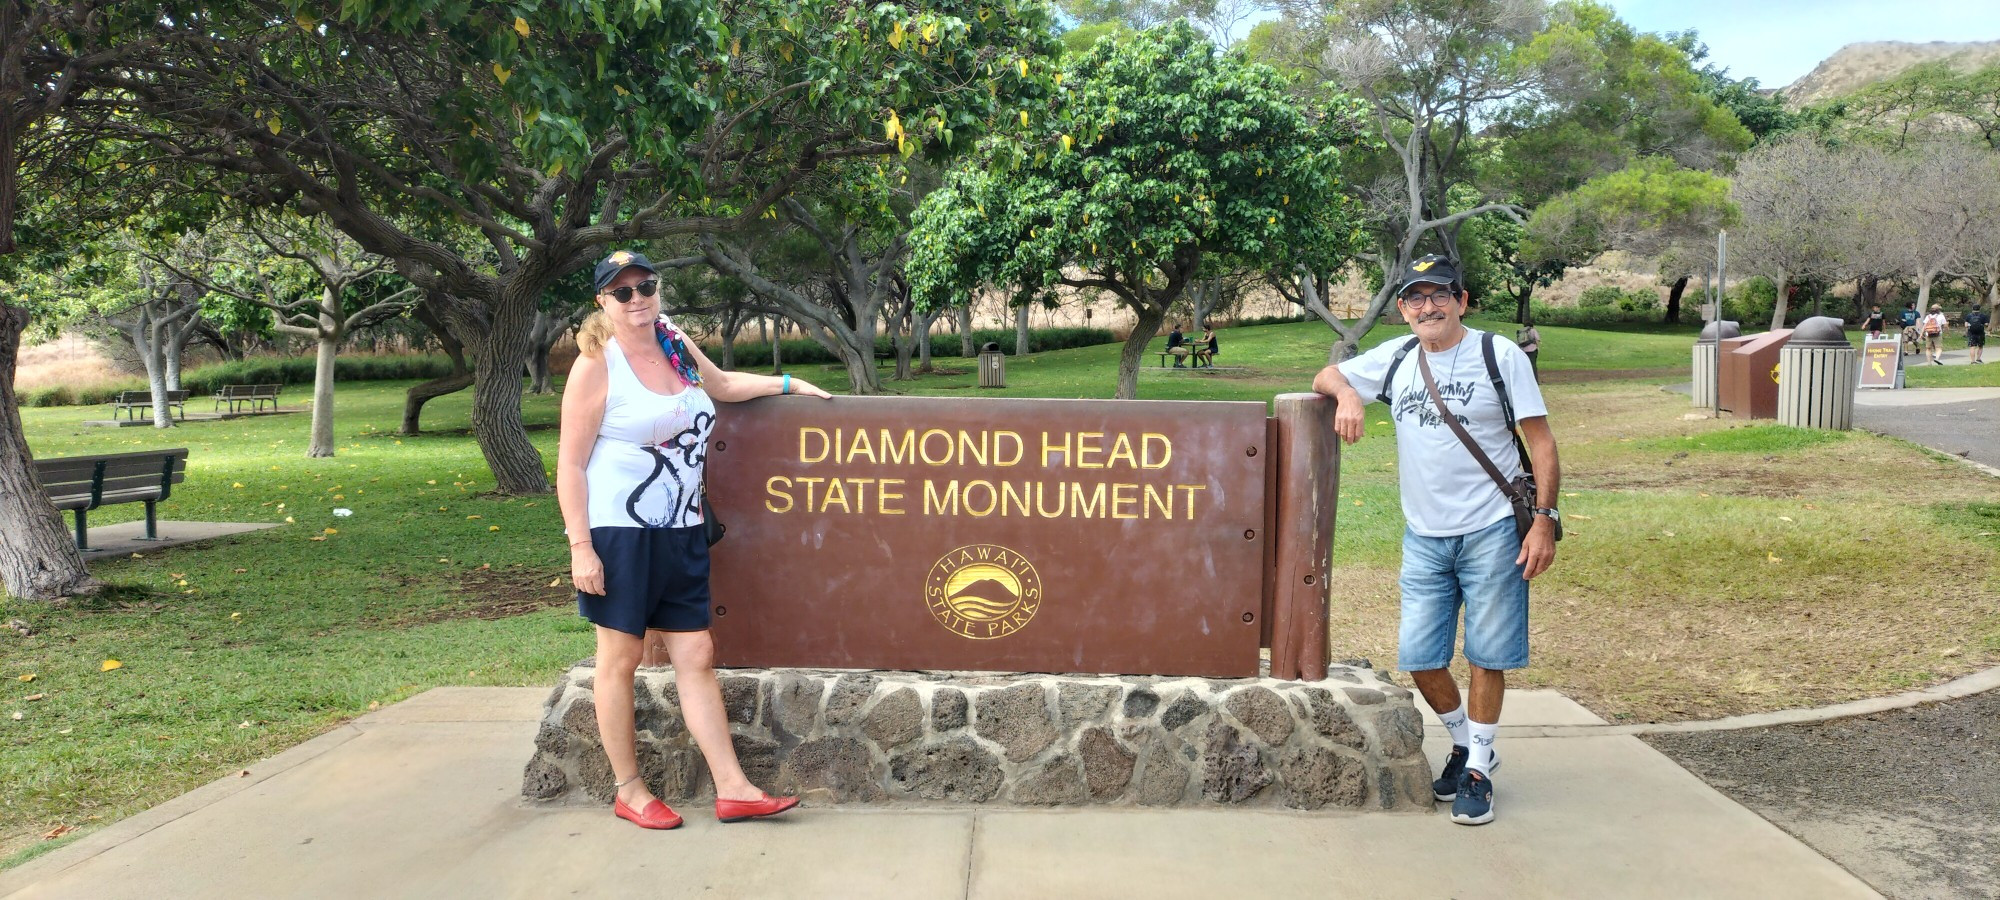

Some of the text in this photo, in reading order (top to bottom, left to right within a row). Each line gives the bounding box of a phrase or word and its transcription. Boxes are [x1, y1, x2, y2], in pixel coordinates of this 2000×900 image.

[800, 427, 1172, 470] DIAMOND HEAD
[765, 475, 1206, 520] STATE MONUMENT
[929, 585, 1039, 636] STATE PARKS
